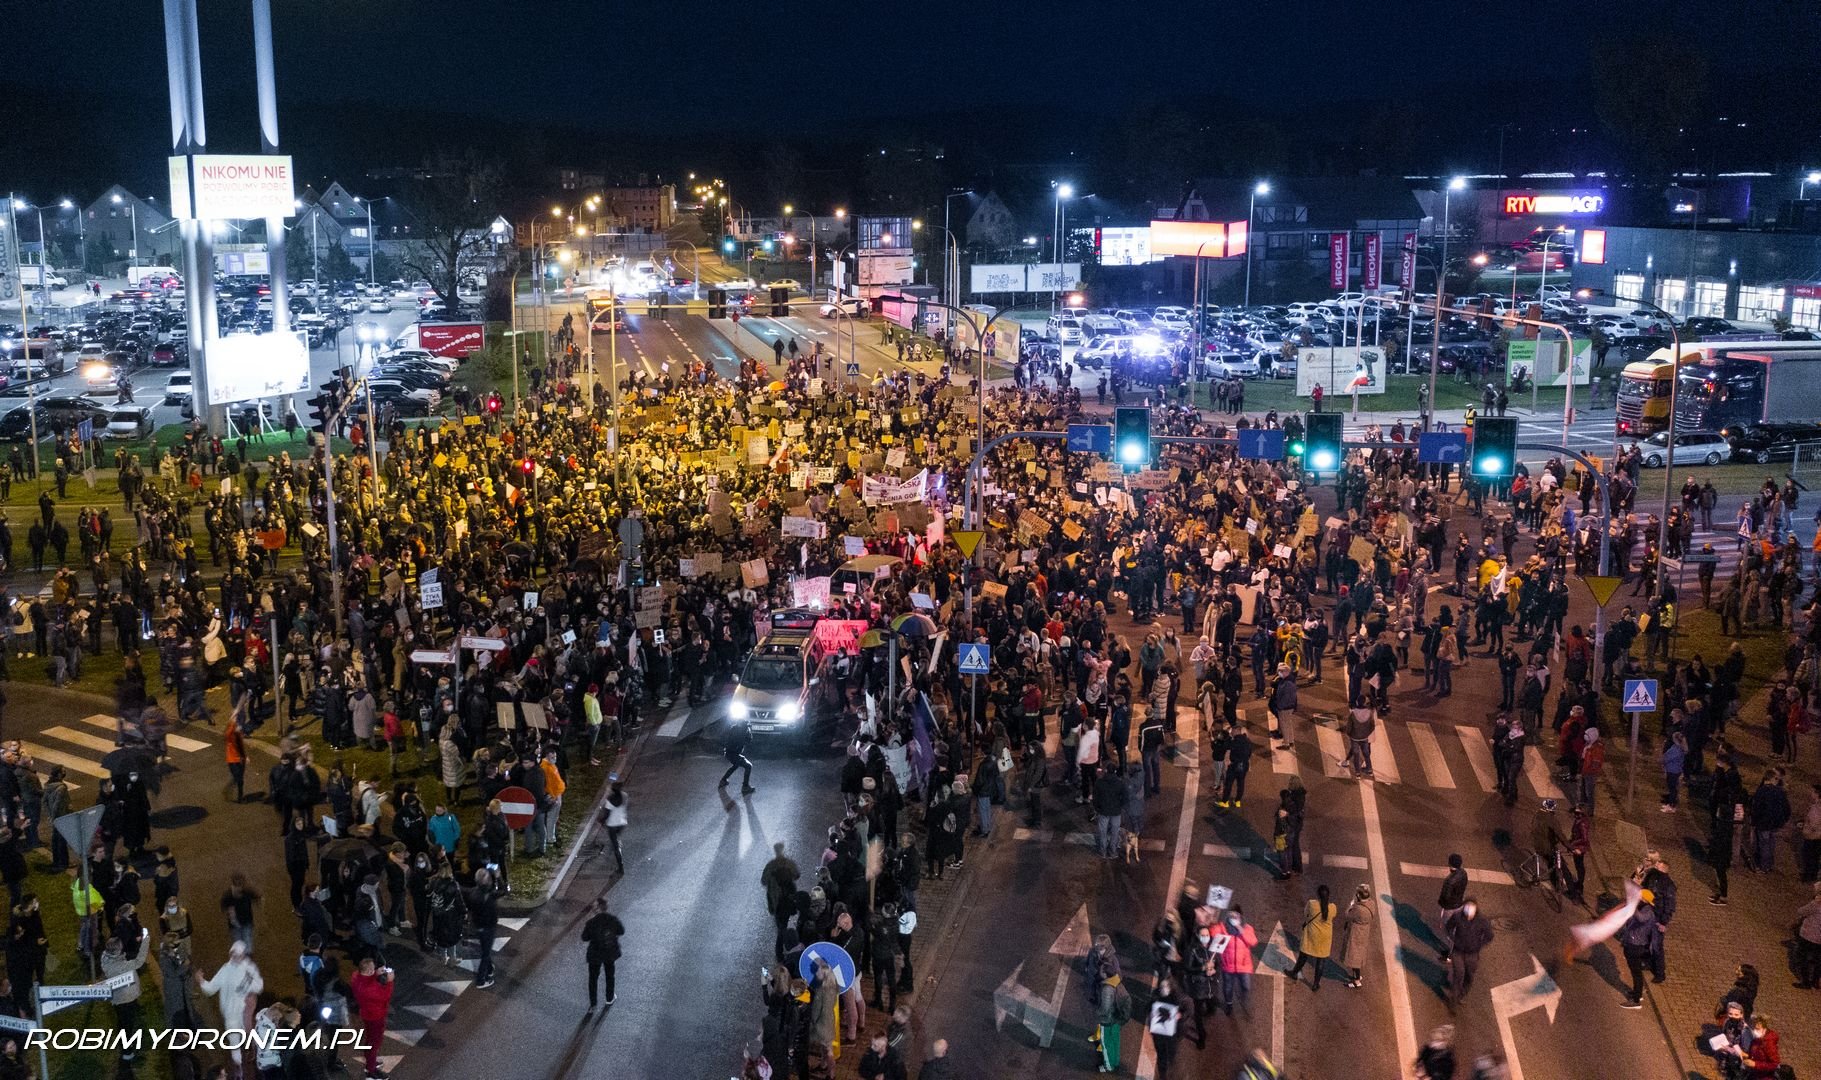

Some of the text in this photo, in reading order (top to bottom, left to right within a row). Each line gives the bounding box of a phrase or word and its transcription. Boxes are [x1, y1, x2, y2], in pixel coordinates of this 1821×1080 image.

[202, 166, 287, 179] NIKOMU NIE
[1506, 196, 1537, 213] RTV
